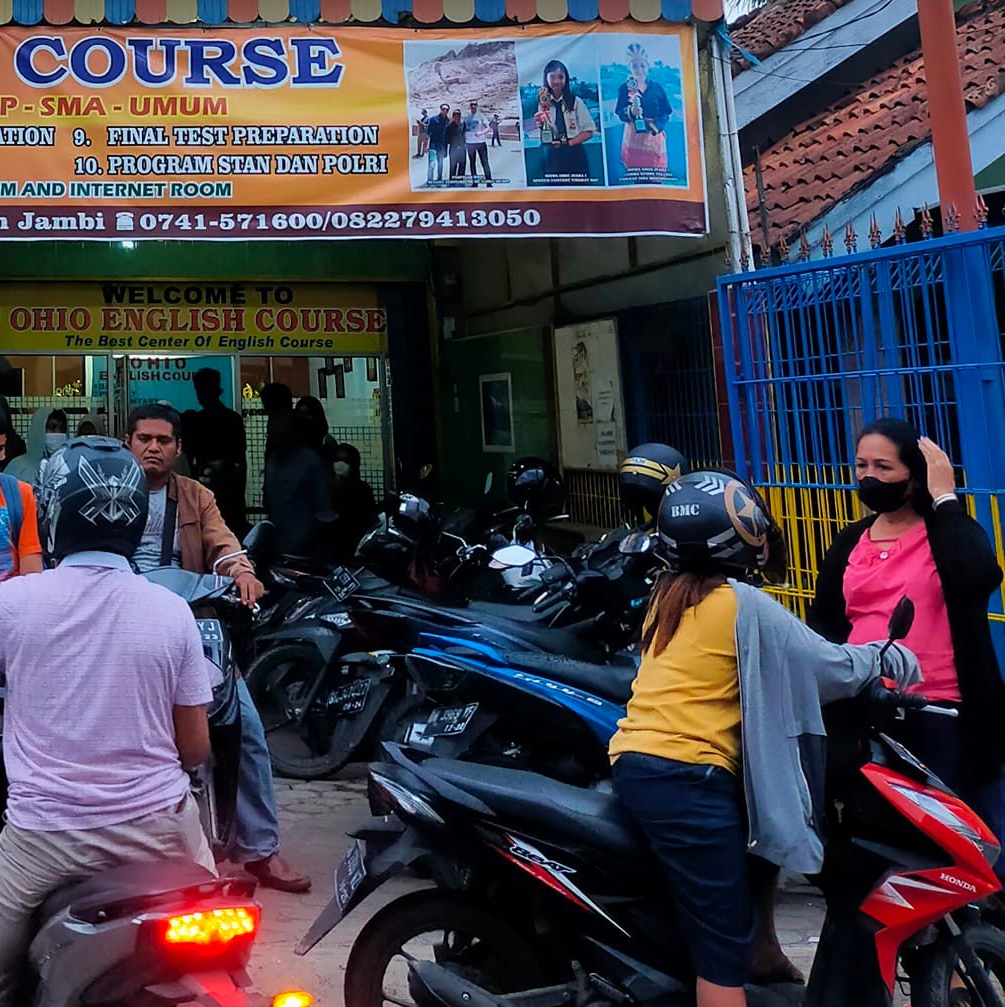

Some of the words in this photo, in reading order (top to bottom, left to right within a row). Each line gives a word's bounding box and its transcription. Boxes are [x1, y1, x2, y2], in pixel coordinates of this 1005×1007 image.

[13, 35, 345, 89] COURSE
[38, 95, 107, 119] SMA
[129, 95, 228, 117] UMUM
[106, 125, 169, 147] FINAL
[172, 125, 228, 147] TEST
[231, 124, 379, 146] PREPARATION
[107, 154, 213, 175] PROGRAM
[217, 154, 271, 175] STAN
[275, 154, 318, 175] DAN
[320, 153, 389, 174] POLRI
[19, 181, 66, 199] AND
[69, 181, 168, 199] INTERNET
[170, 181, 233, 198] ROOM
[16, 211, 106, 232] Jambi
[139, 209, 541, 233] 0741-571600/082279413050
[101, 285, 246, 305] WELCOME
[255, 285, 294, 305] TO
[9, 306, 92, 333] OHIO
[100, 306, 246, 333] ENGLISH
[254, 306, 388, 334] COURSE
[65, 334, 93, 347] The
[98, 334, 133, 347] Best
[137, 334, 190, 347] Center
[194, 335, 212, 348] Of
[218, 335, 275, 351] English
[280, 335, 334, 348] Course
[131, 357, 187, 369] OHIO
[671, 503, 700, 518] BMC
[940, 872, 977, 893] HONDA
